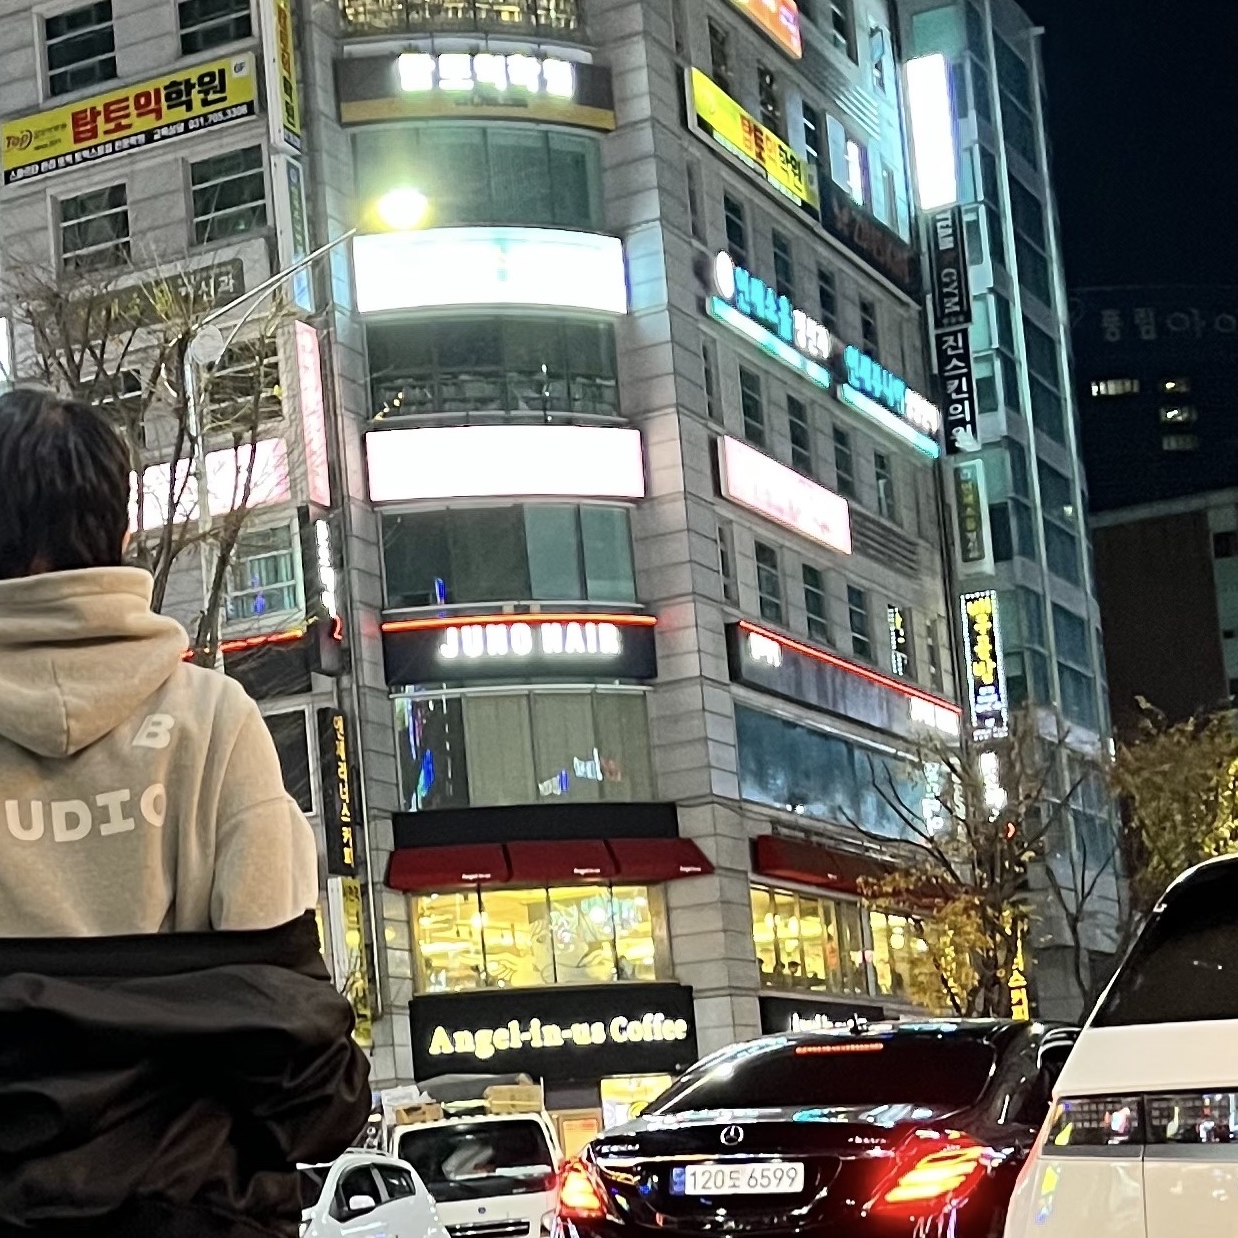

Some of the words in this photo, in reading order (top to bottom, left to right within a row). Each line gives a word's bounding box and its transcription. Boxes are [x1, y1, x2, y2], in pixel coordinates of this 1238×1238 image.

[70, 68, 228, 145] 탑토익학원
[940, 267, 961, 314] GYM
[439, 622, 533, 659] JUNO
[540, 621, 622, 655] HAIR
[428, 1017, 606, 1060] Angel-in-us
[609, 1012, 688, 1044] Coffee
[689, 1168, 741, 1191] 120도
[746, 1166, 799, 1189] 6599
